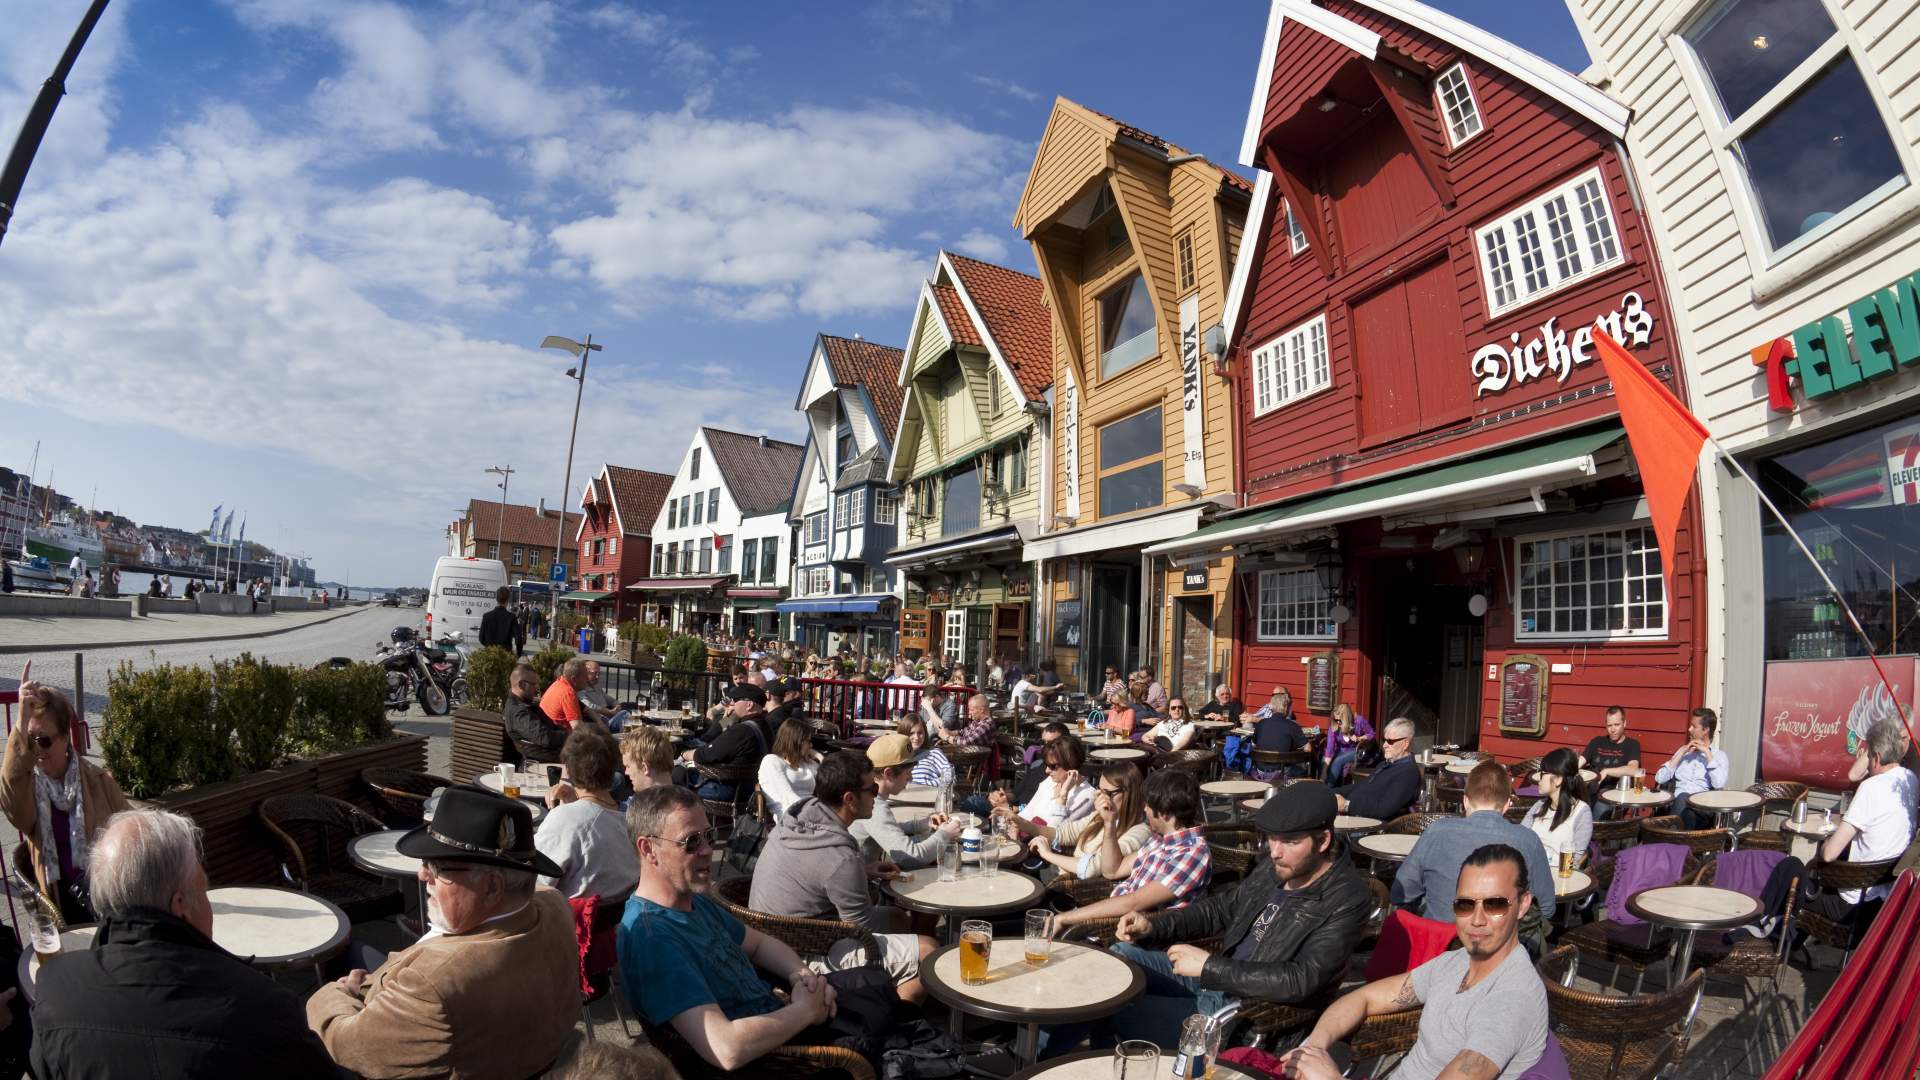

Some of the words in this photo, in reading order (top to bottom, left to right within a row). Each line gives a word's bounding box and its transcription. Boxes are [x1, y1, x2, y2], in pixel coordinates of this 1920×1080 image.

[1471, 291, 1653, 397] Dickens
[1064, 386, 1077, 498] backstage
[553, 565, 563, 579] P
[444, 588, 458, 596] MUR
[1771, 710, 1807, 737] Frozen
[1801, 713, 1841, 742] Yogurt
